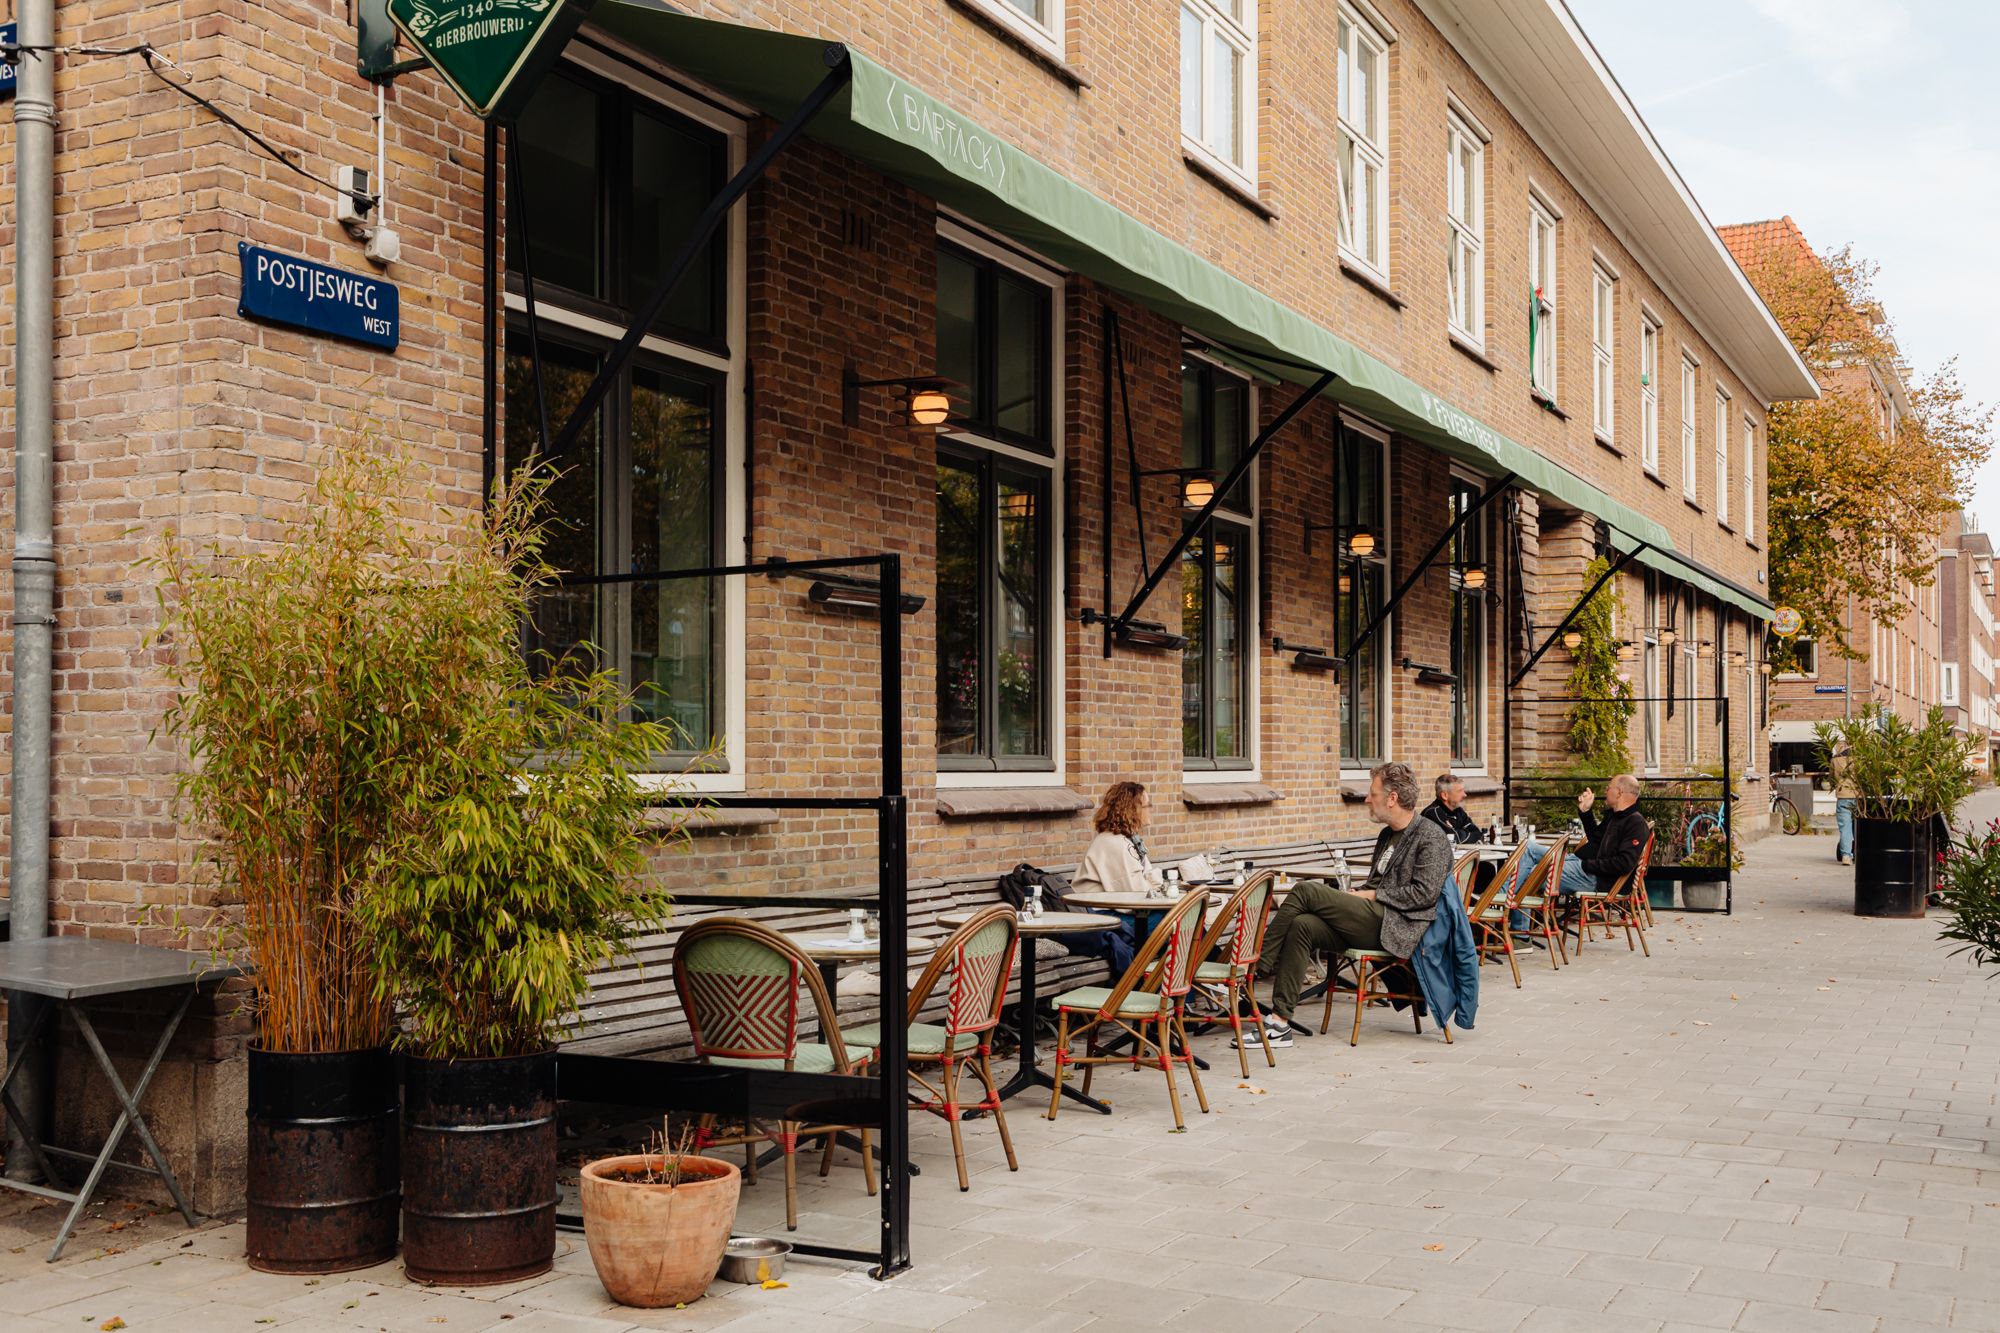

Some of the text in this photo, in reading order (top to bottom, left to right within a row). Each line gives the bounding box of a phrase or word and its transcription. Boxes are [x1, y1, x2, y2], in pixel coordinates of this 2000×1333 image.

[461, 0, 494, 19] 1340
[436, 18, 524, 48] BIERBROUWERIJ
[904, 94, 994, 177] BARTACK
[257, 255, 377, 310] POSTJESWEG
[363, 316, 391, 336] WEST
